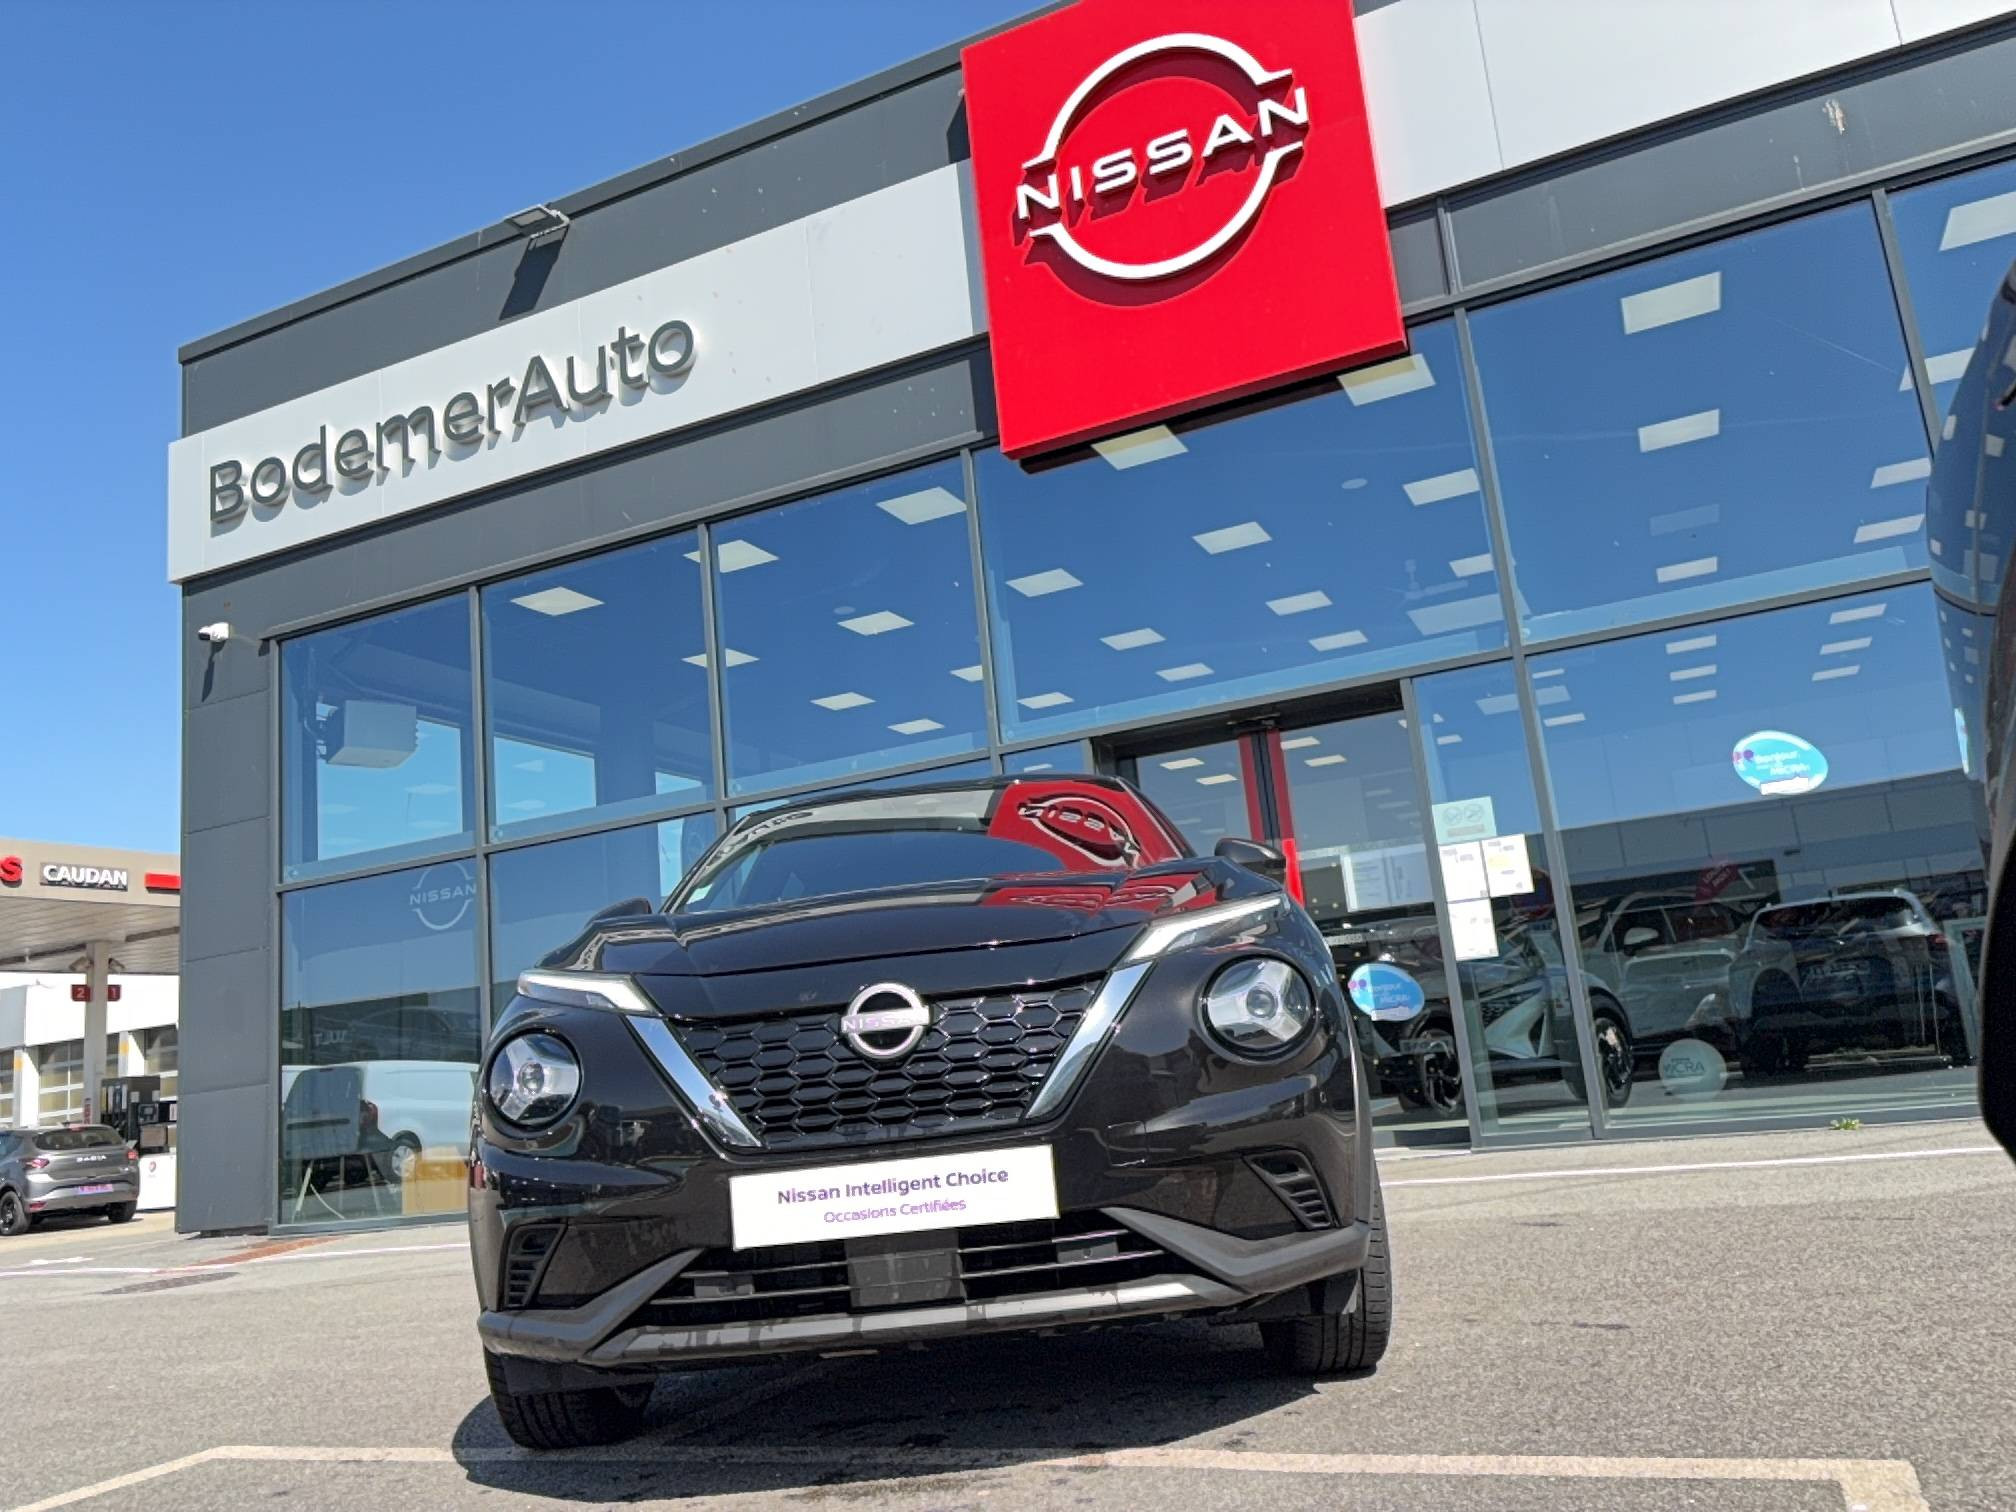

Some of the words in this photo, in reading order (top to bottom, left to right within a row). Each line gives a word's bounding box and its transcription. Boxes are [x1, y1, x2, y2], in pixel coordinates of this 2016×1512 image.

[1016, 87, 1309, 219] NISSAN
[209, 318, 695, 523] BodemerAuto
[43, 865, 127, 885] CAUDAN
[409, 883, 477, 905] NISSAN
[76, 987, 85, 999] 2
[778, 1188, 840, 1204] Nissan
[846, 1174, 941, 1197] Intelligent
[946, 1168, 1009, 1186] Choice
[824, 1207, 897, 1223] Occasions
